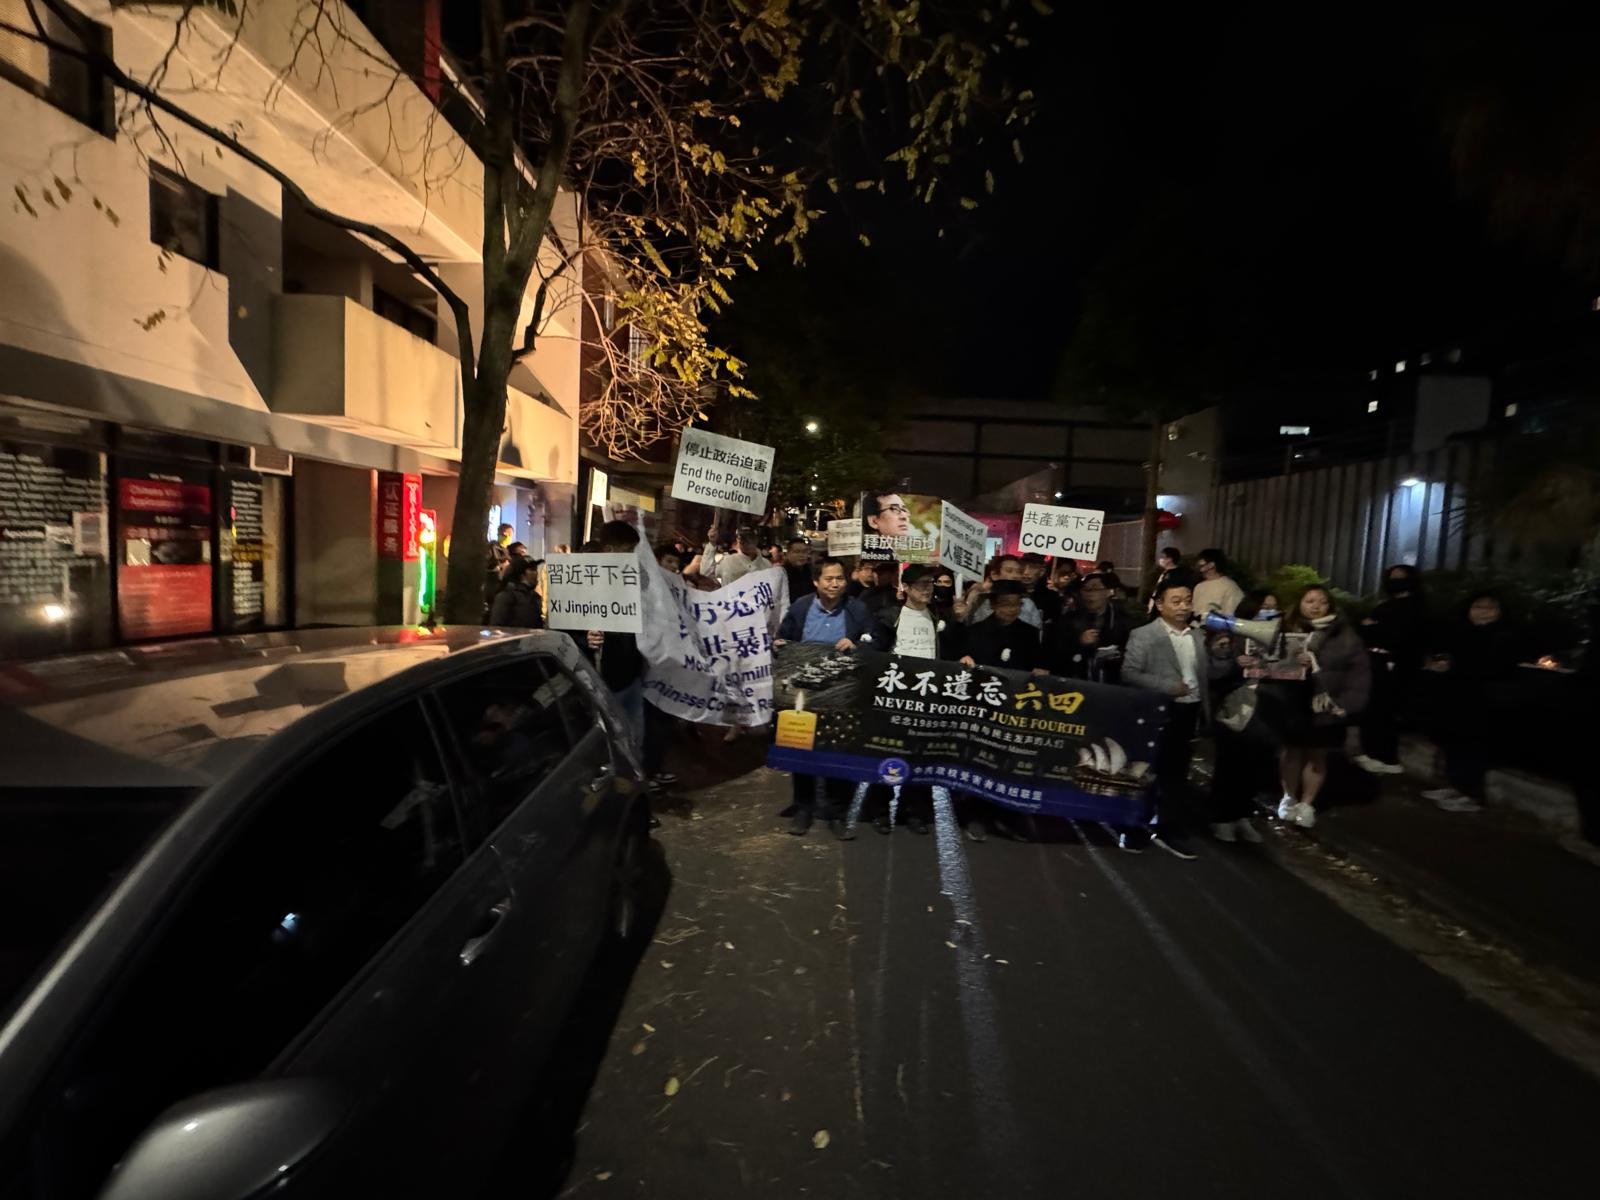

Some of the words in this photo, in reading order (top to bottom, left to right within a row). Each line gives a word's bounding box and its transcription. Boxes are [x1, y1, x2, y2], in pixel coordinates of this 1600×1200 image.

[685, 441, 768, 472] 停止政治迫害
[681, 463, 702, 478] End
[705, 468, 722, 483] the
[725, 473, 768, 493] Political
[687, 480, 751, 504] Persecution
[1024, 511, 1101, 531] 共產黨下台
[1022, 533, 1056, 549] CCP
[1061, 537, 1096, 554] Out!
[861, 551, 890, 560] Release
[548, 564, 638, 586] 習近平下台
[550, 599, 562, 613] Xi
[565, 600, 607, 618] Jinping
[611, 601, 637, 616] Out!
[873, 696, 925, 713] NEVER
[929, 702, 987, 718] FORGET
[989, 711, 1027, 728] JUNE
[1030, 719, 1086, 737] FOURTH
